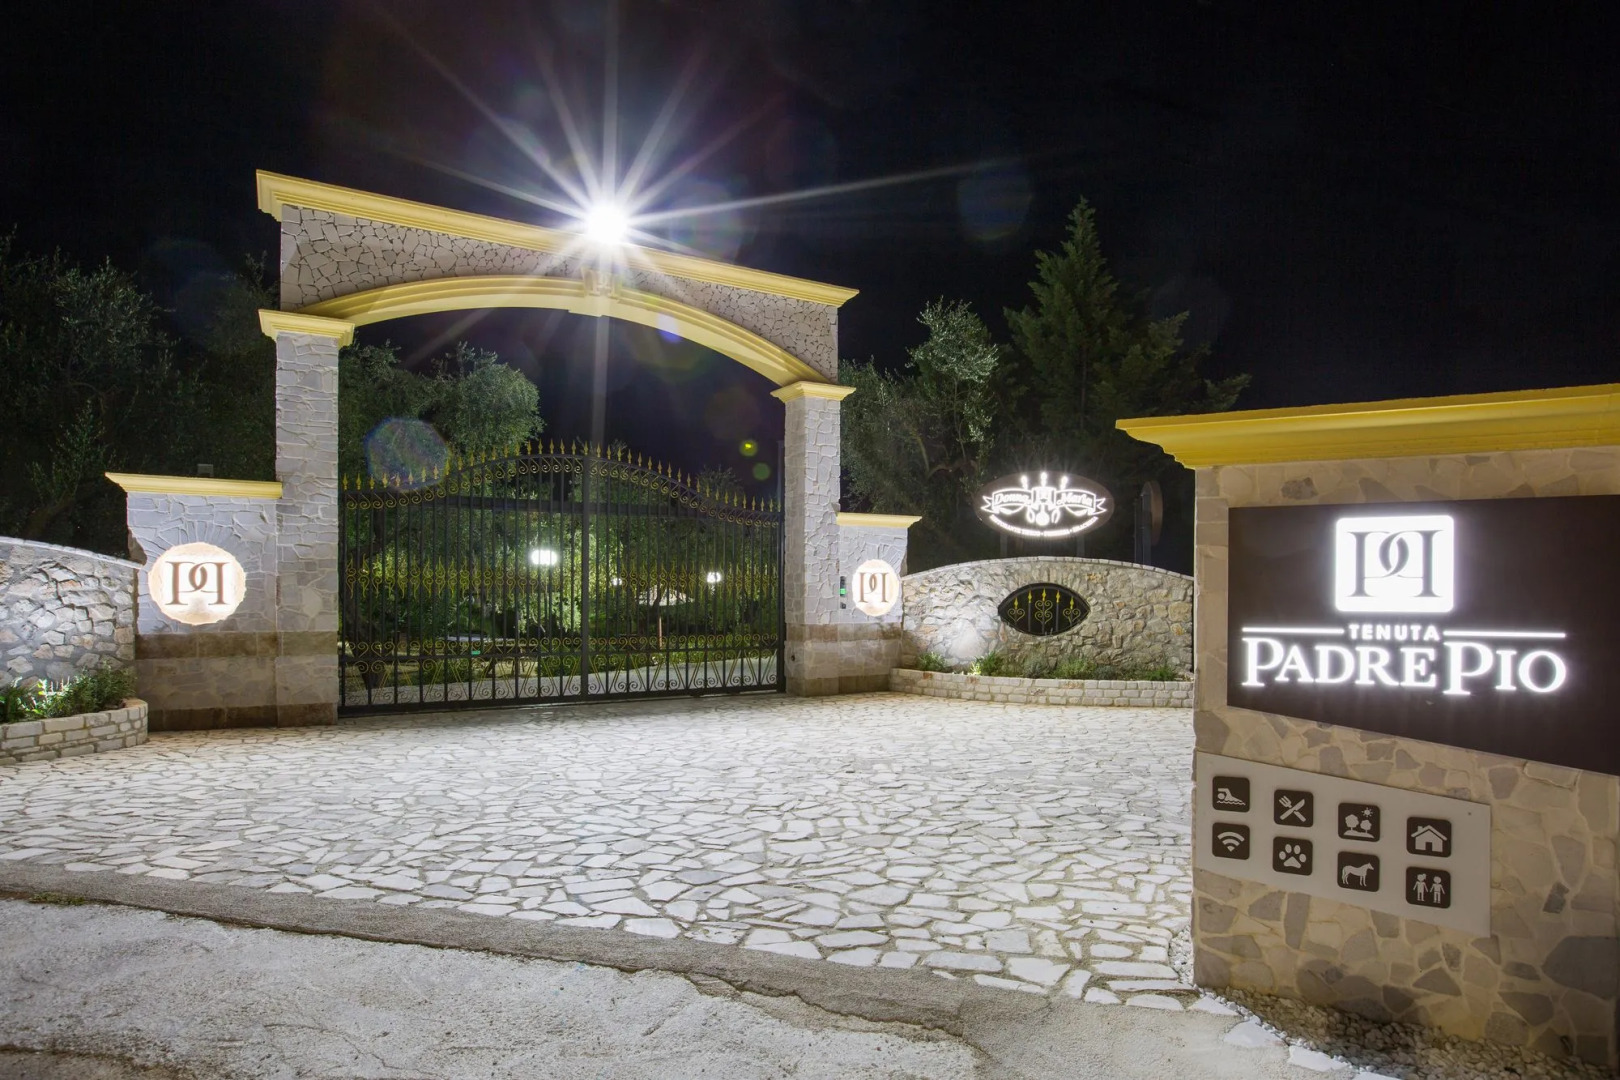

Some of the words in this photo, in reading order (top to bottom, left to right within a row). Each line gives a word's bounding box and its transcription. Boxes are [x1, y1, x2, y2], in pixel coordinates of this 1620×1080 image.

[1348, 623, 1441, 641] TENUTA
[1241, 637, 1437, 688] PADRE
[1442, 641, 1567, 695] PIO
